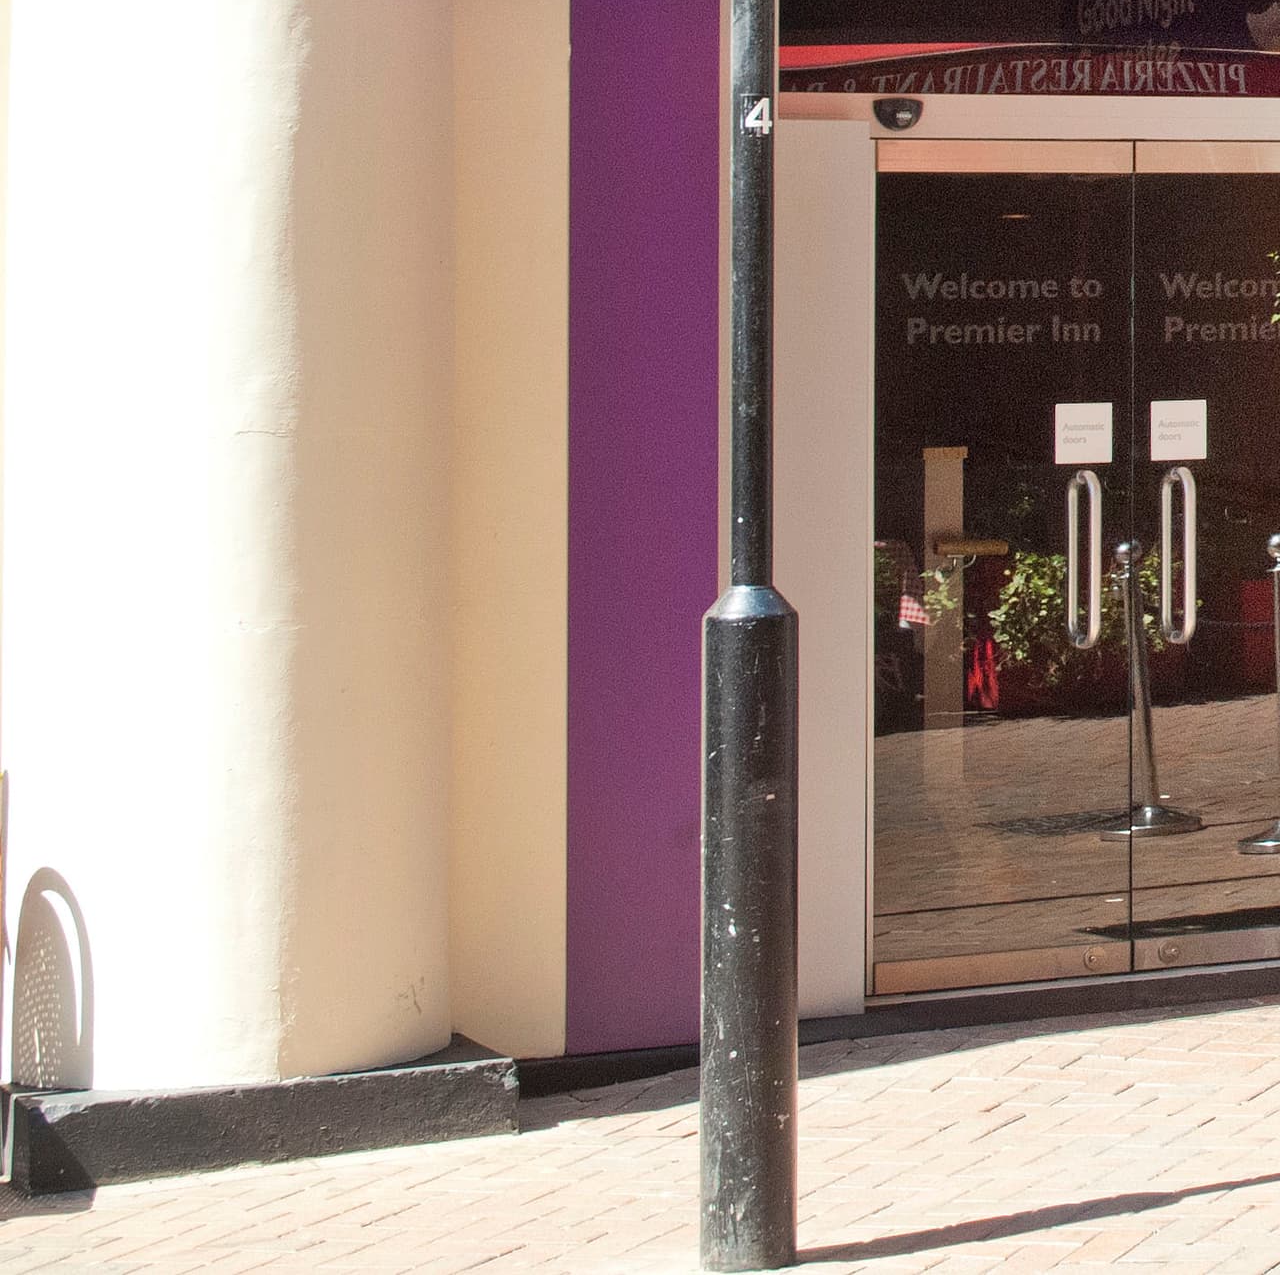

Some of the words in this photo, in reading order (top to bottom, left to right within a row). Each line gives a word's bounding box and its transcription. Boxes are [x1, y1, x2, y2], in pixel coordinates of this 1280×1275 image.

[745, 97, 773, 135] 4
[903, 273, 1059, 299] Welcome
[1068, 276, 1101, 299] to
[906, 317, 1041, 345] Premier
[1052, 315, 1100, 344] Inn
[1062, 422, 1105, 432] Automatic
[1158, 419, 1200, 429] Automatic
[1062, 435, 1087, 444] doors
[1158, 432, 1182, 441] doors
